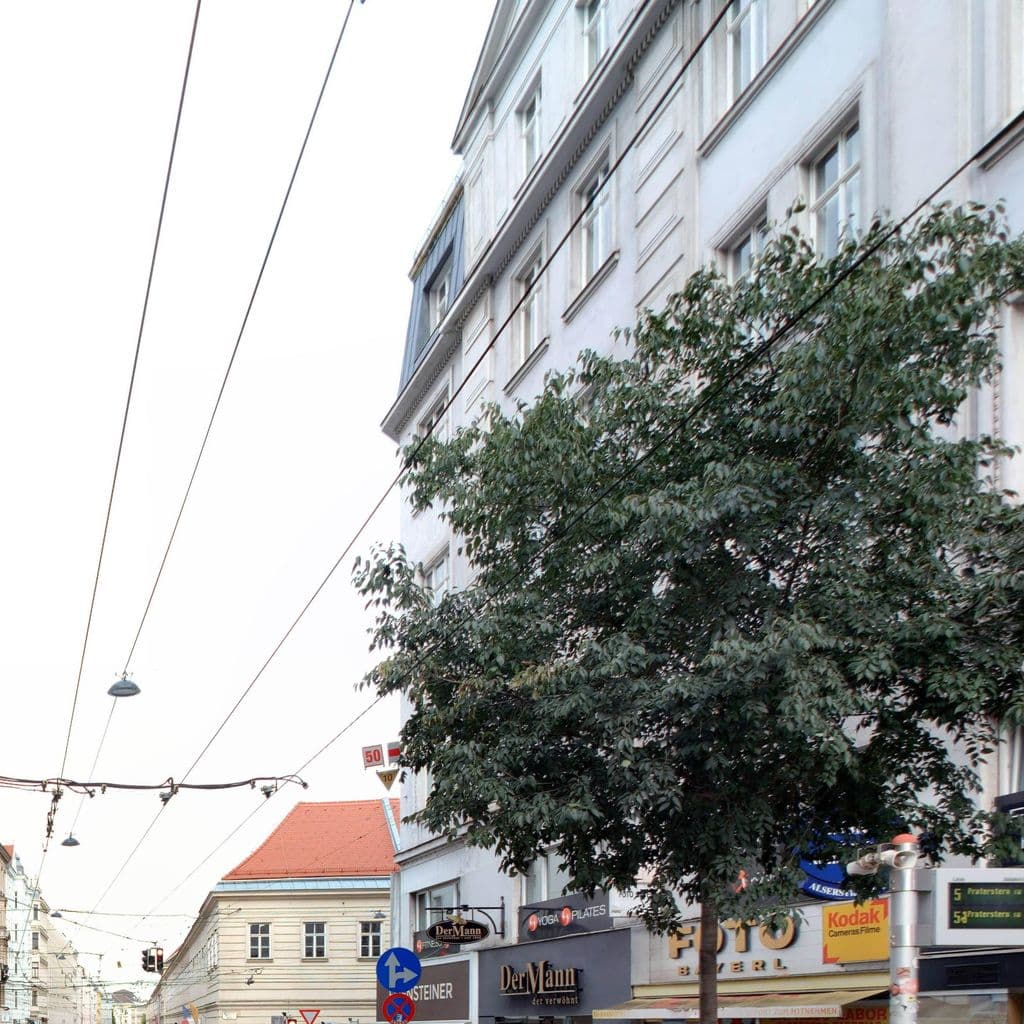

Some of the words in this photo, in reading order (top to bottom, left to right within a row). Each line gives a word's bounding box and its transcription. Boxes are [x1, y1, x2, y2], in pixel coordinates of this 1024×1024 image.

[364, 749, 382, 764] 50
[953, 887, 962, 901] 5
[538, 914, 560, 926] YOGA
[571, 904, 607, 921] PILATES
[828, 908, 881, 929] Kodak
